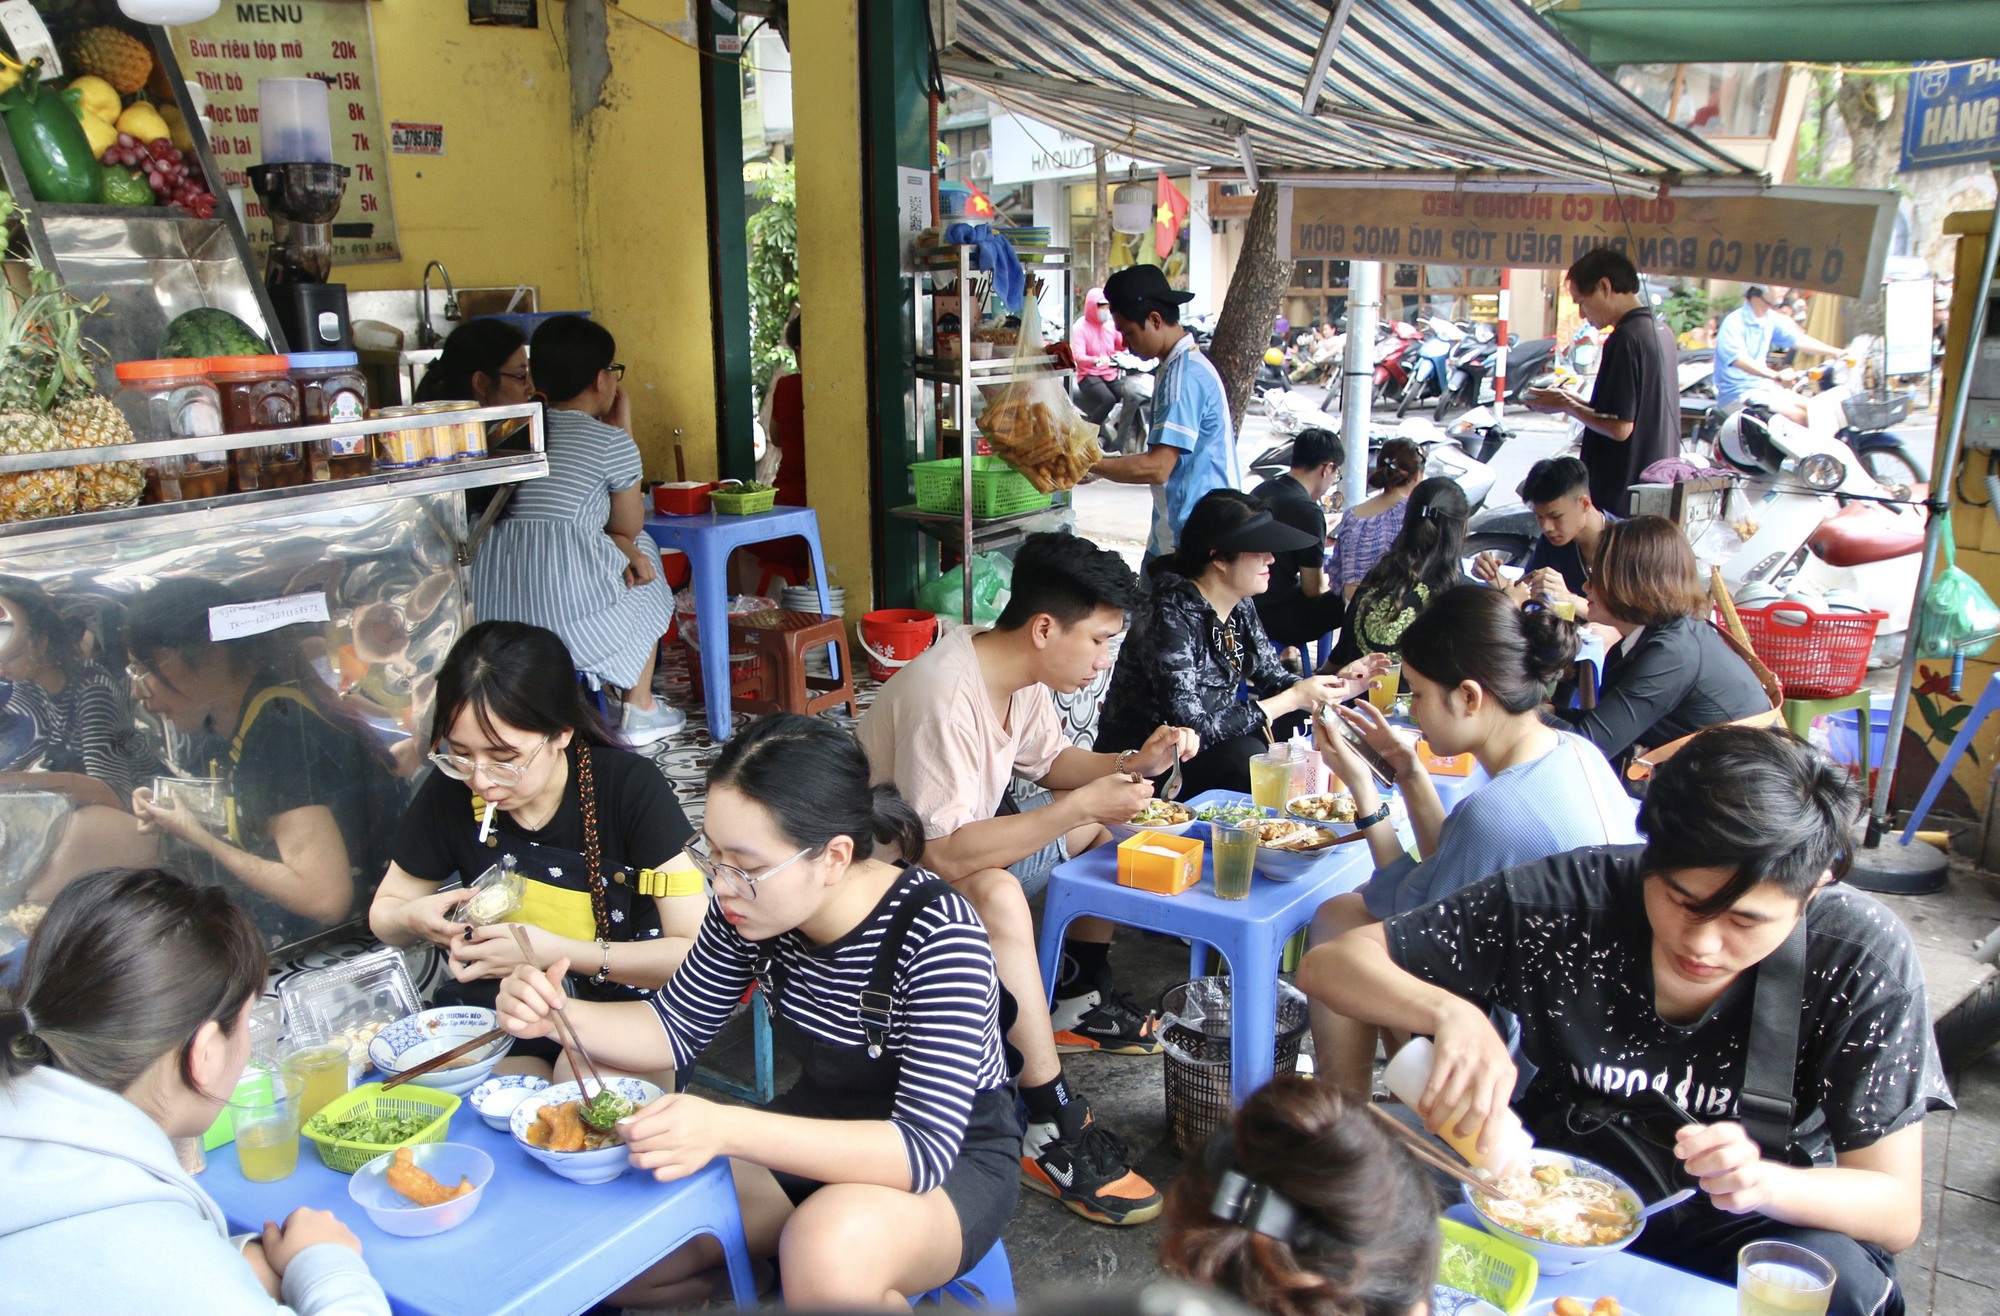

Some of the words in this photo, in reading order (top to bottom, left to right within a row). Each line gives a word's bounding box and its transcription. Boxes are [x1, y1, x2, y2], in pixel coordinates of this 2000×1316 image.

[236, 5, 303, 24] MENU
[221, 39, 250, 59] riêu
[332, 40, 357, 60] 20k
[196, 71, 223, 94] Thịt
[348, 103, 366, 121] 8k
[1921, 95, 1999, 148] HÀNG
[233, 135, 252, 155] tai
[352, 134, 370, 152] 7k
[356, 164, 374, 182] 7k
[360, 194, 378, 212] 5k
[1055, 1081, 1069, 1106] WORLD
